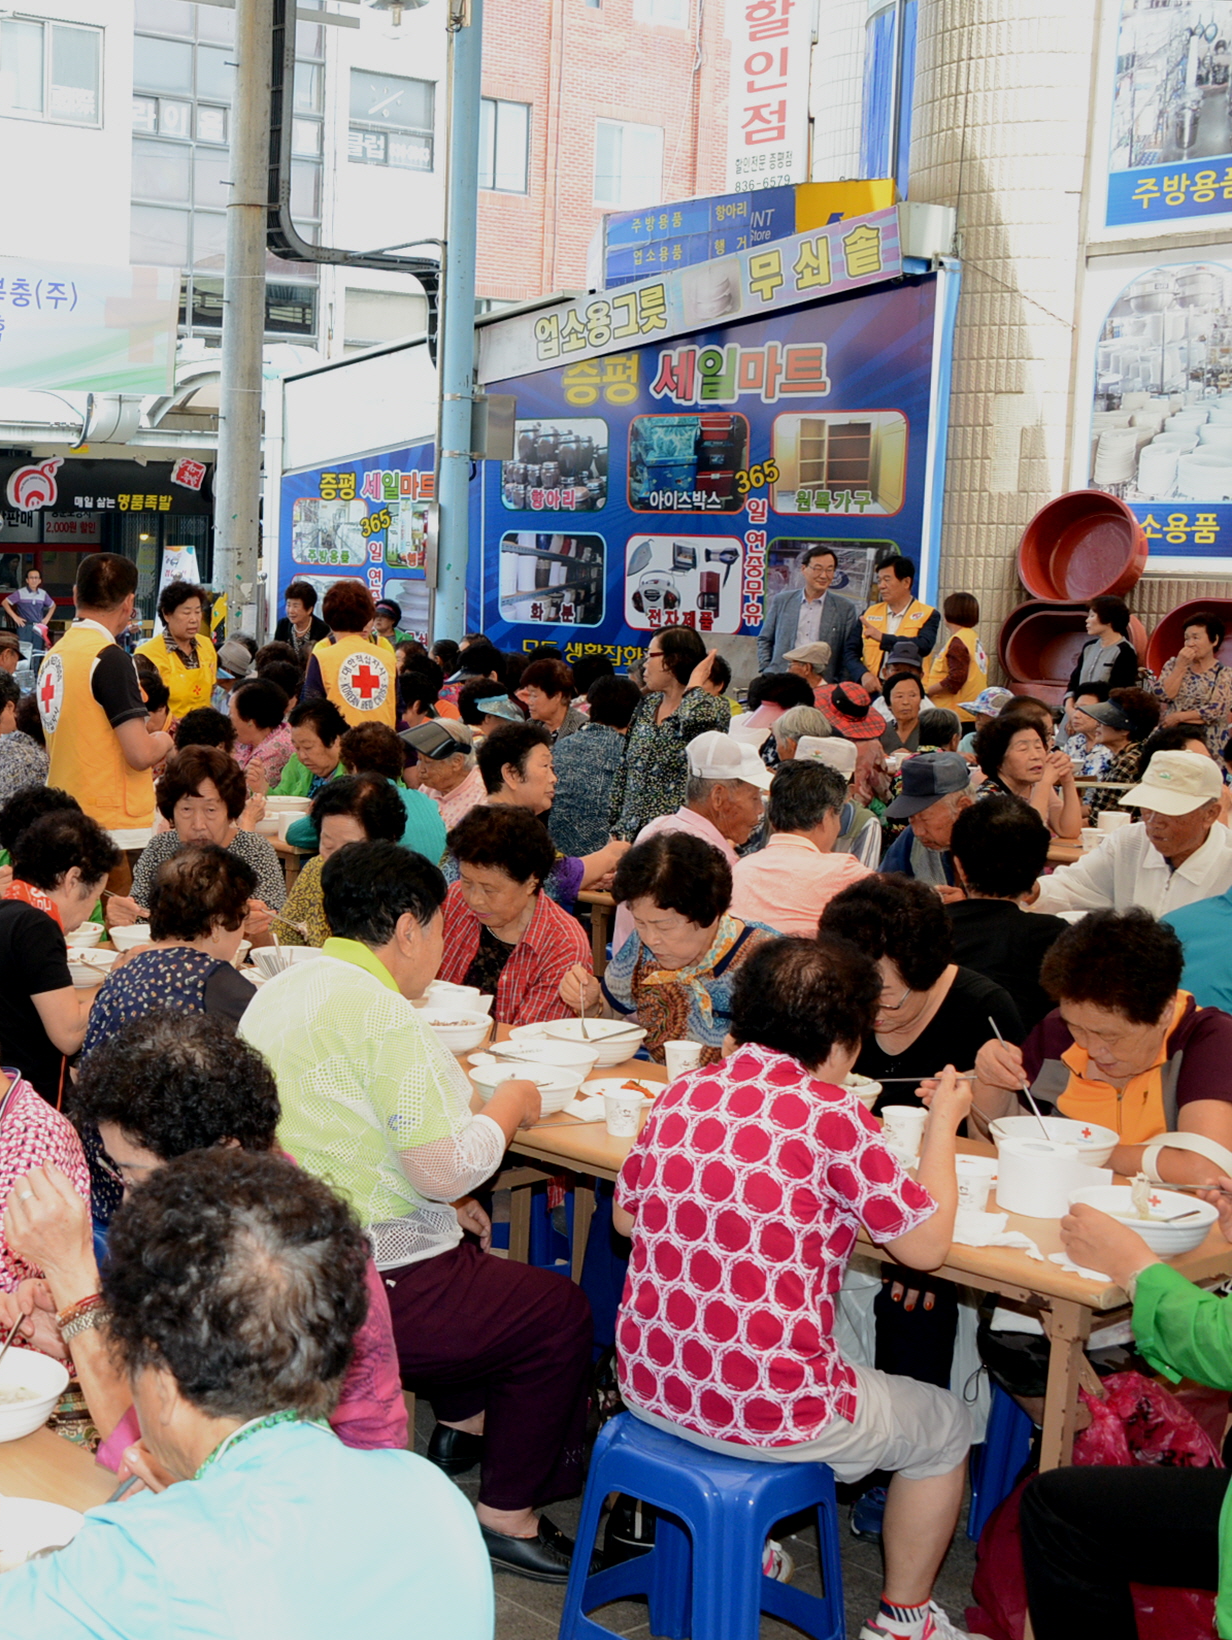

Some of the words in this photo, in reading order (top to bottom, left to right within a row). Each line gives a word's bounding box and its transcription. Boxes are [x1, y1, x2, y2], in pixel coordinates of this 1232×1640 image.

[735, 174, 791, 193] 836-6579
[631, 212, 683, 233] 주방용품
[714, 201, 748, 222] 항아리
[633, 244, 683, 266] 업소용품
[748, 224, 883, 302] 무쇠솥
[534, 283, 667, 359] 업소용그릇
[561, 352, 640, 406] 증평
[652, 345, 829, 402] 세일마트
[319, 472, 356, 500] 증평
[734, 459, 780, 494] 365
[74, 496, 93, 508] 매일
[96, 496, 115, 508] 삶는
[118, 494, 173, 511] 명품족발
[531, 489, 576, 510] 항아리
[650, 490, 722, 511] 아이스박스
[795, 489, 872, 513] 원목가구
[46, 521, 77, 534] 2,000원
[80, 521, 96, 534] 할인
[360, 509, 391, 537] 365
[1139, 513, 1220, 544] 소용품
[307, 549, 350, 563] 주방용품
[745, 530, 768, 627] 연중무휴
[530, 602, 574, 624] 화분
[648, 607, 715, 632] 전자제품
